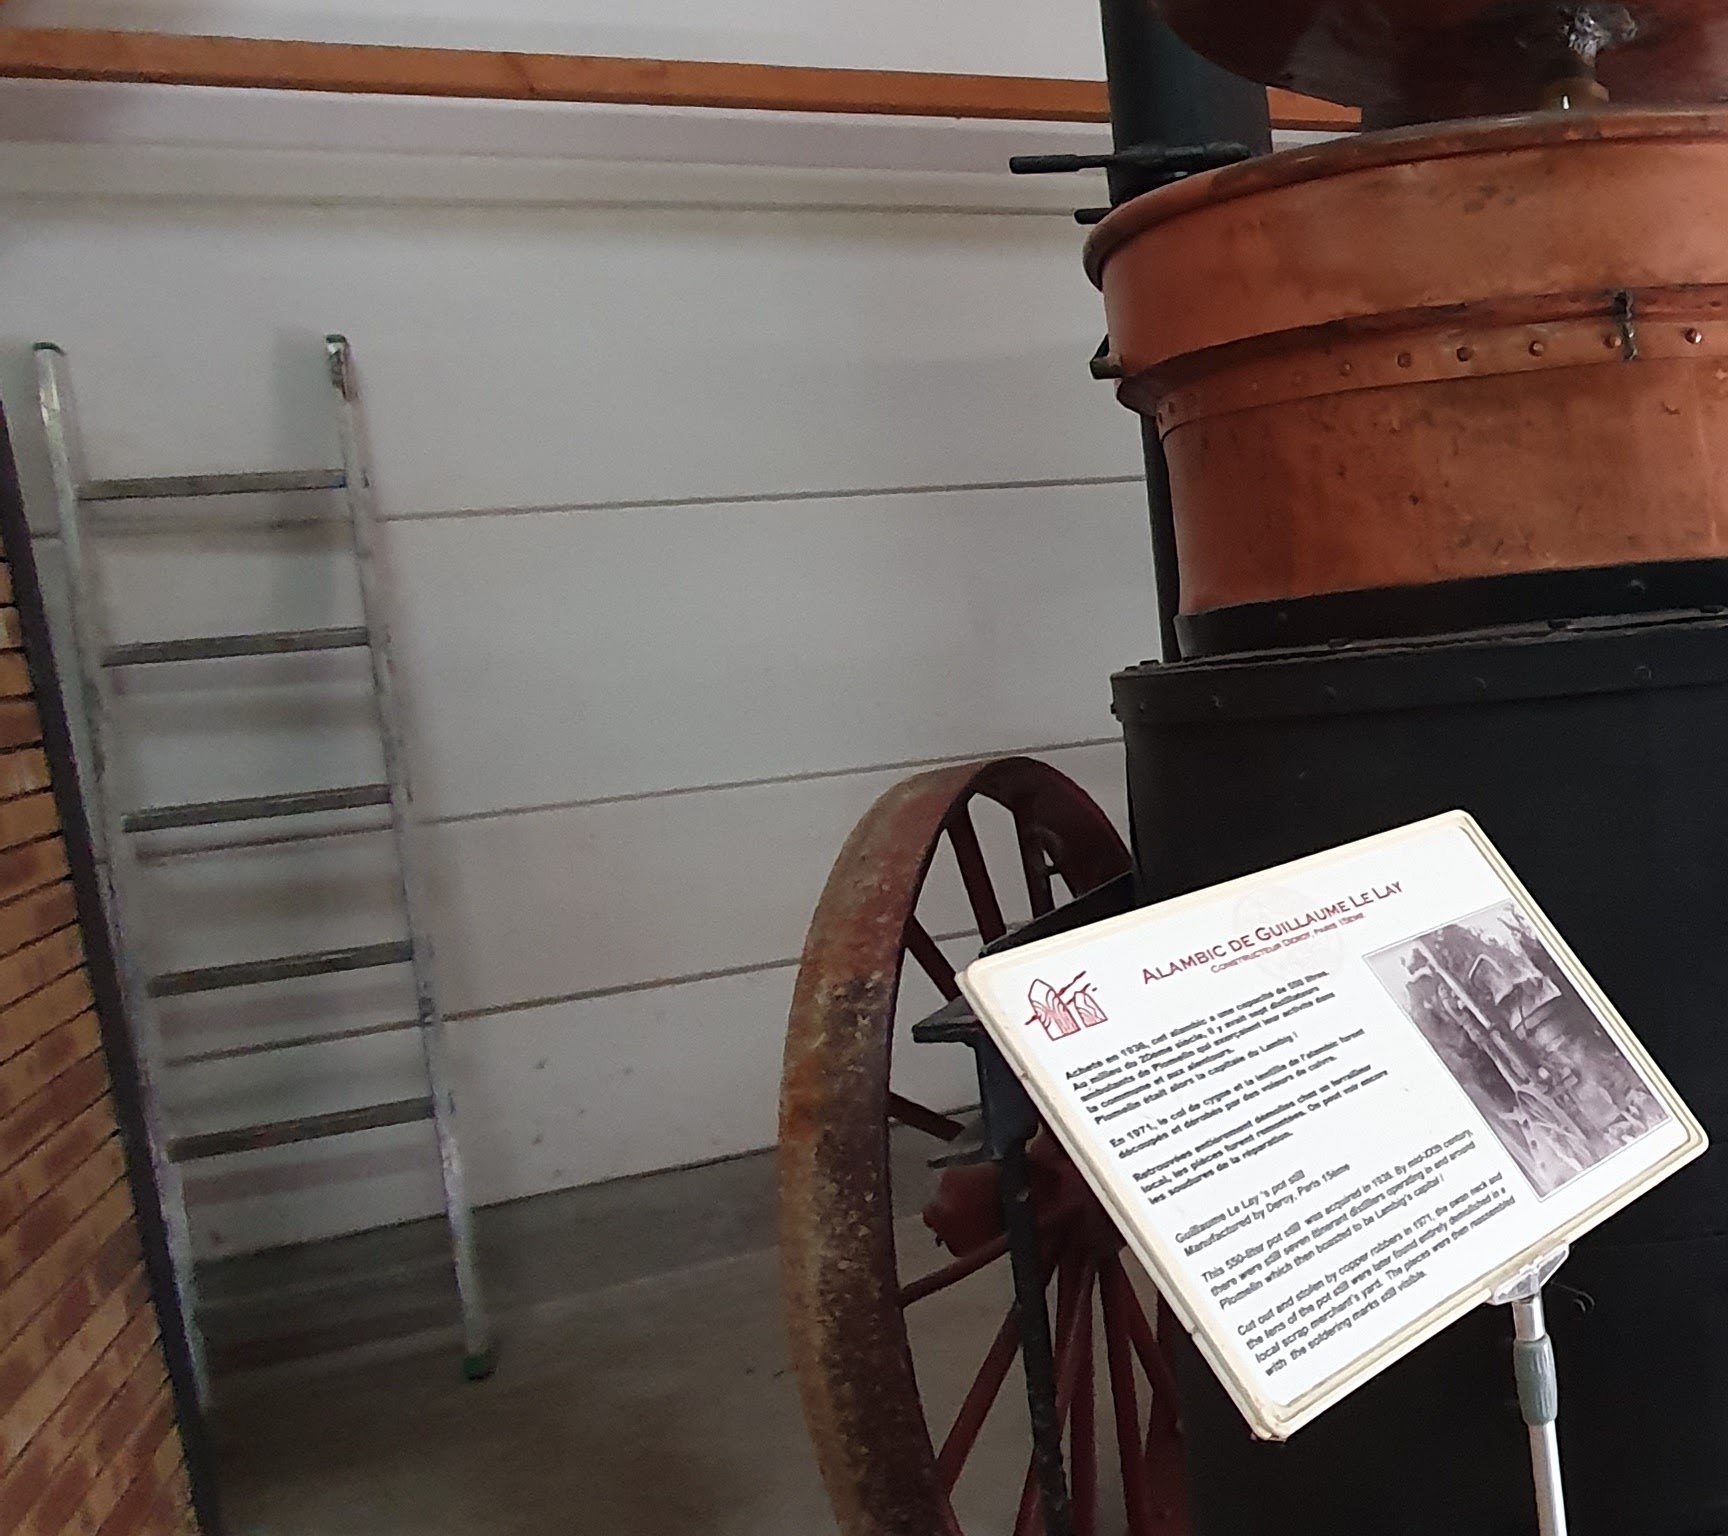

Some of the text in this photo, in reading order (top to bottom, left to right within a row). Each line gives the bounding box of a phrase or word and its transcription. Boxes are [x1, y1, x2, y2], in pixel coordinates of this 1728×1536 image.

[1141, 880, 1402, 984] ALAMBIC DE GUILLAUME LE LAY
